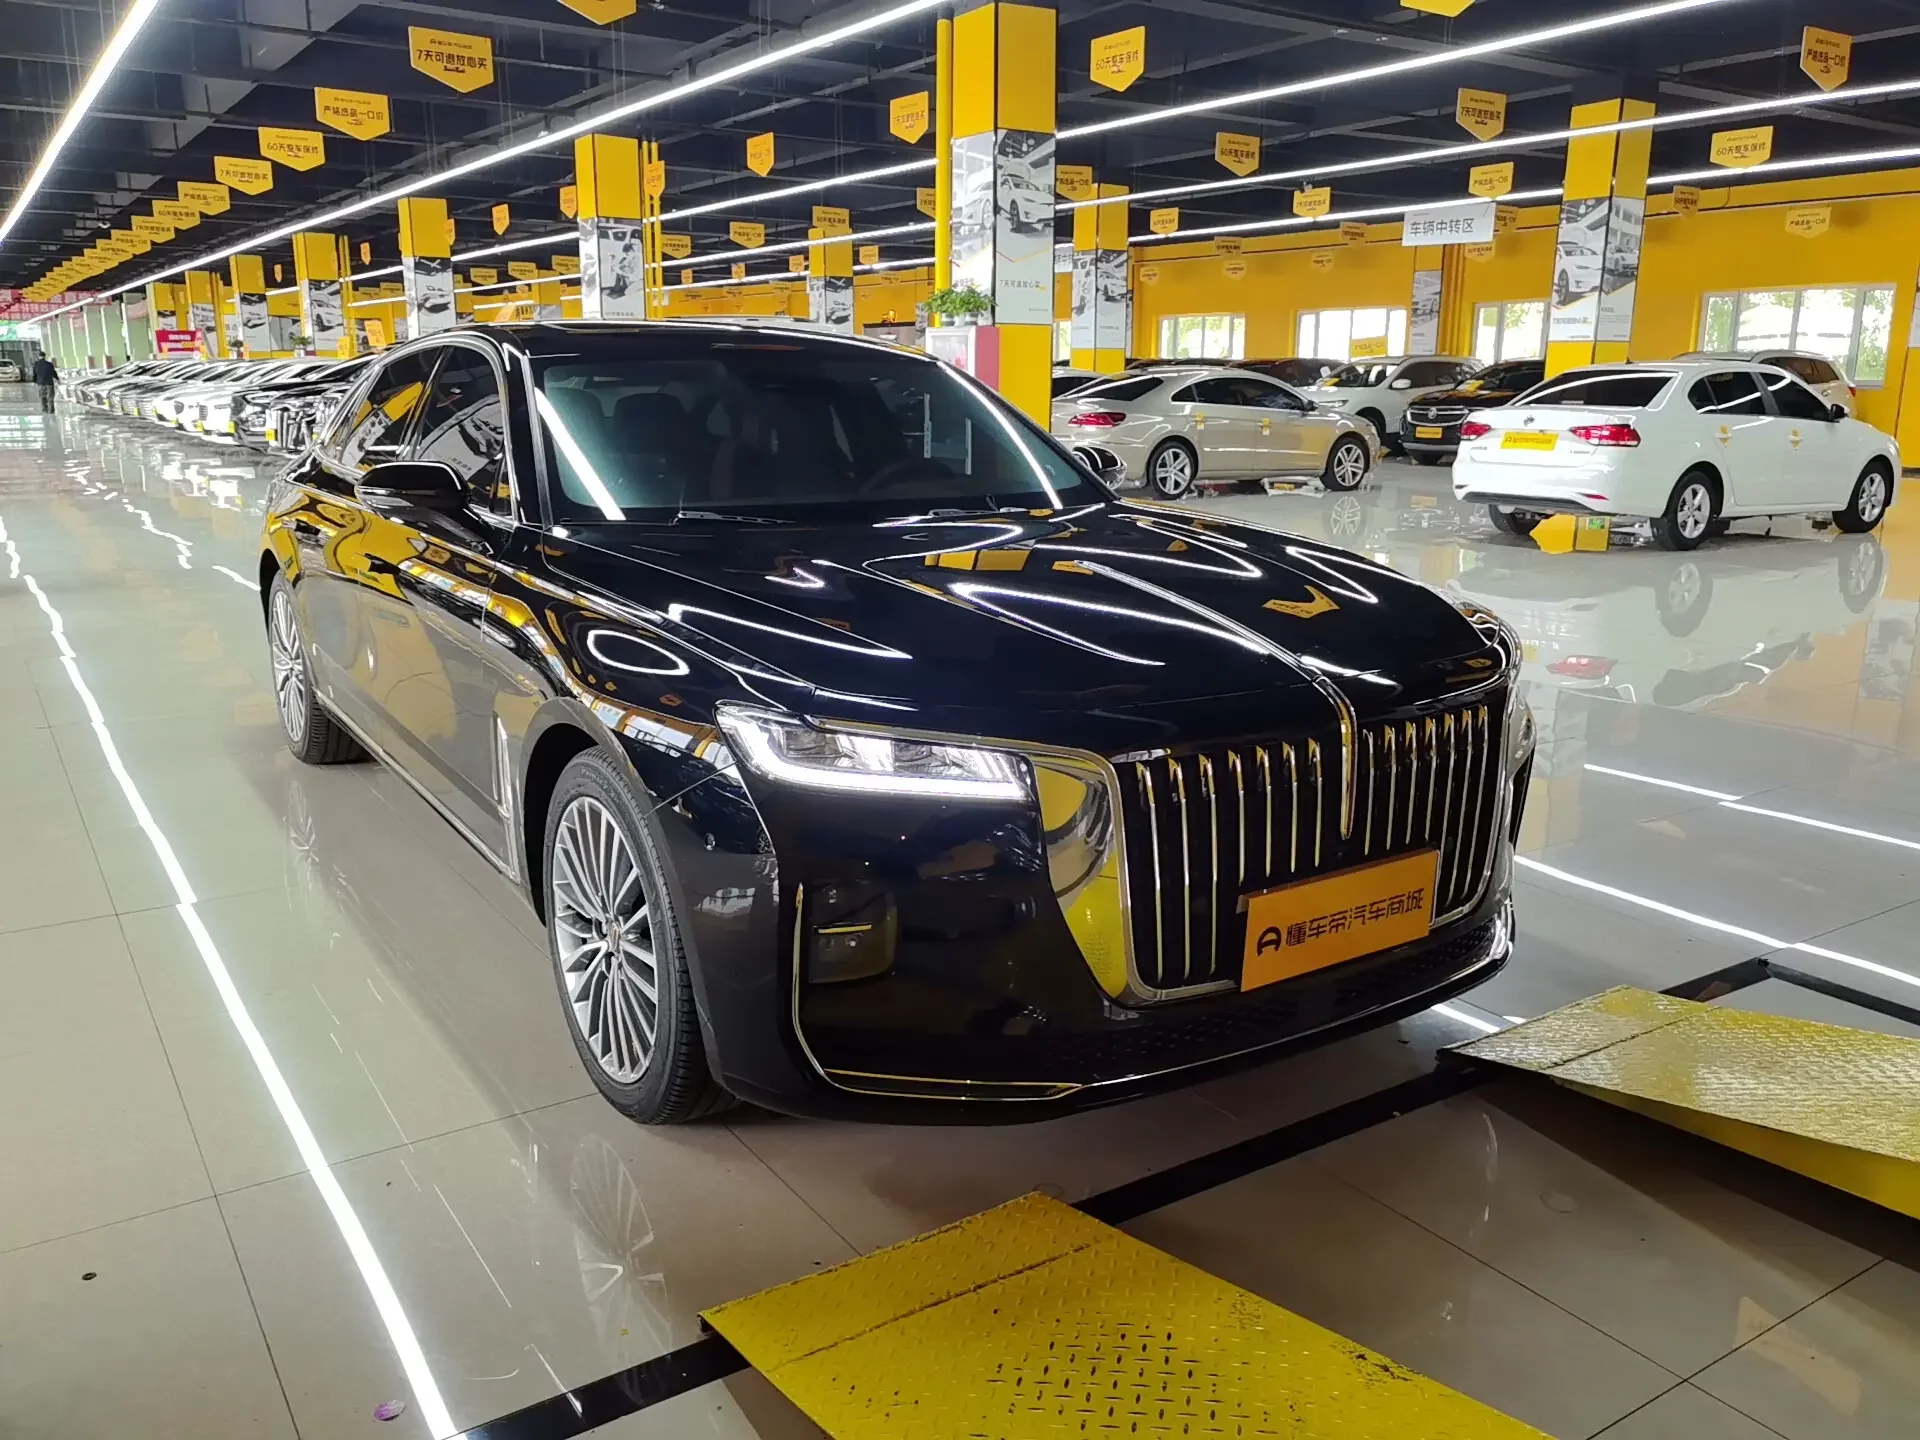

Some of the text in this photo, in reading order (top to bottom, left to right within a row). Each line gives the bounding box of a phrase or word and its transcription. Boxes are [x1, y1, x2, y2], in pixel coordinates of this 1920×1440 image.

[416, 48, 488, 70] 7天可退放心买
[1096, 49, 1140, 70] 60天整车保修
[323, 105, 384, 121] 严格选品一口价
[266, 142, 320, 155] 60天整车保修
[1716, 141, 1767, 157] 60天整车保修
[1410, 217, 1475, 237] 车辆中转区
[999, 279, 1042, 289] 7天可退放心买
[1285, 887, 1425, 947] 懂车帝汽车商城
